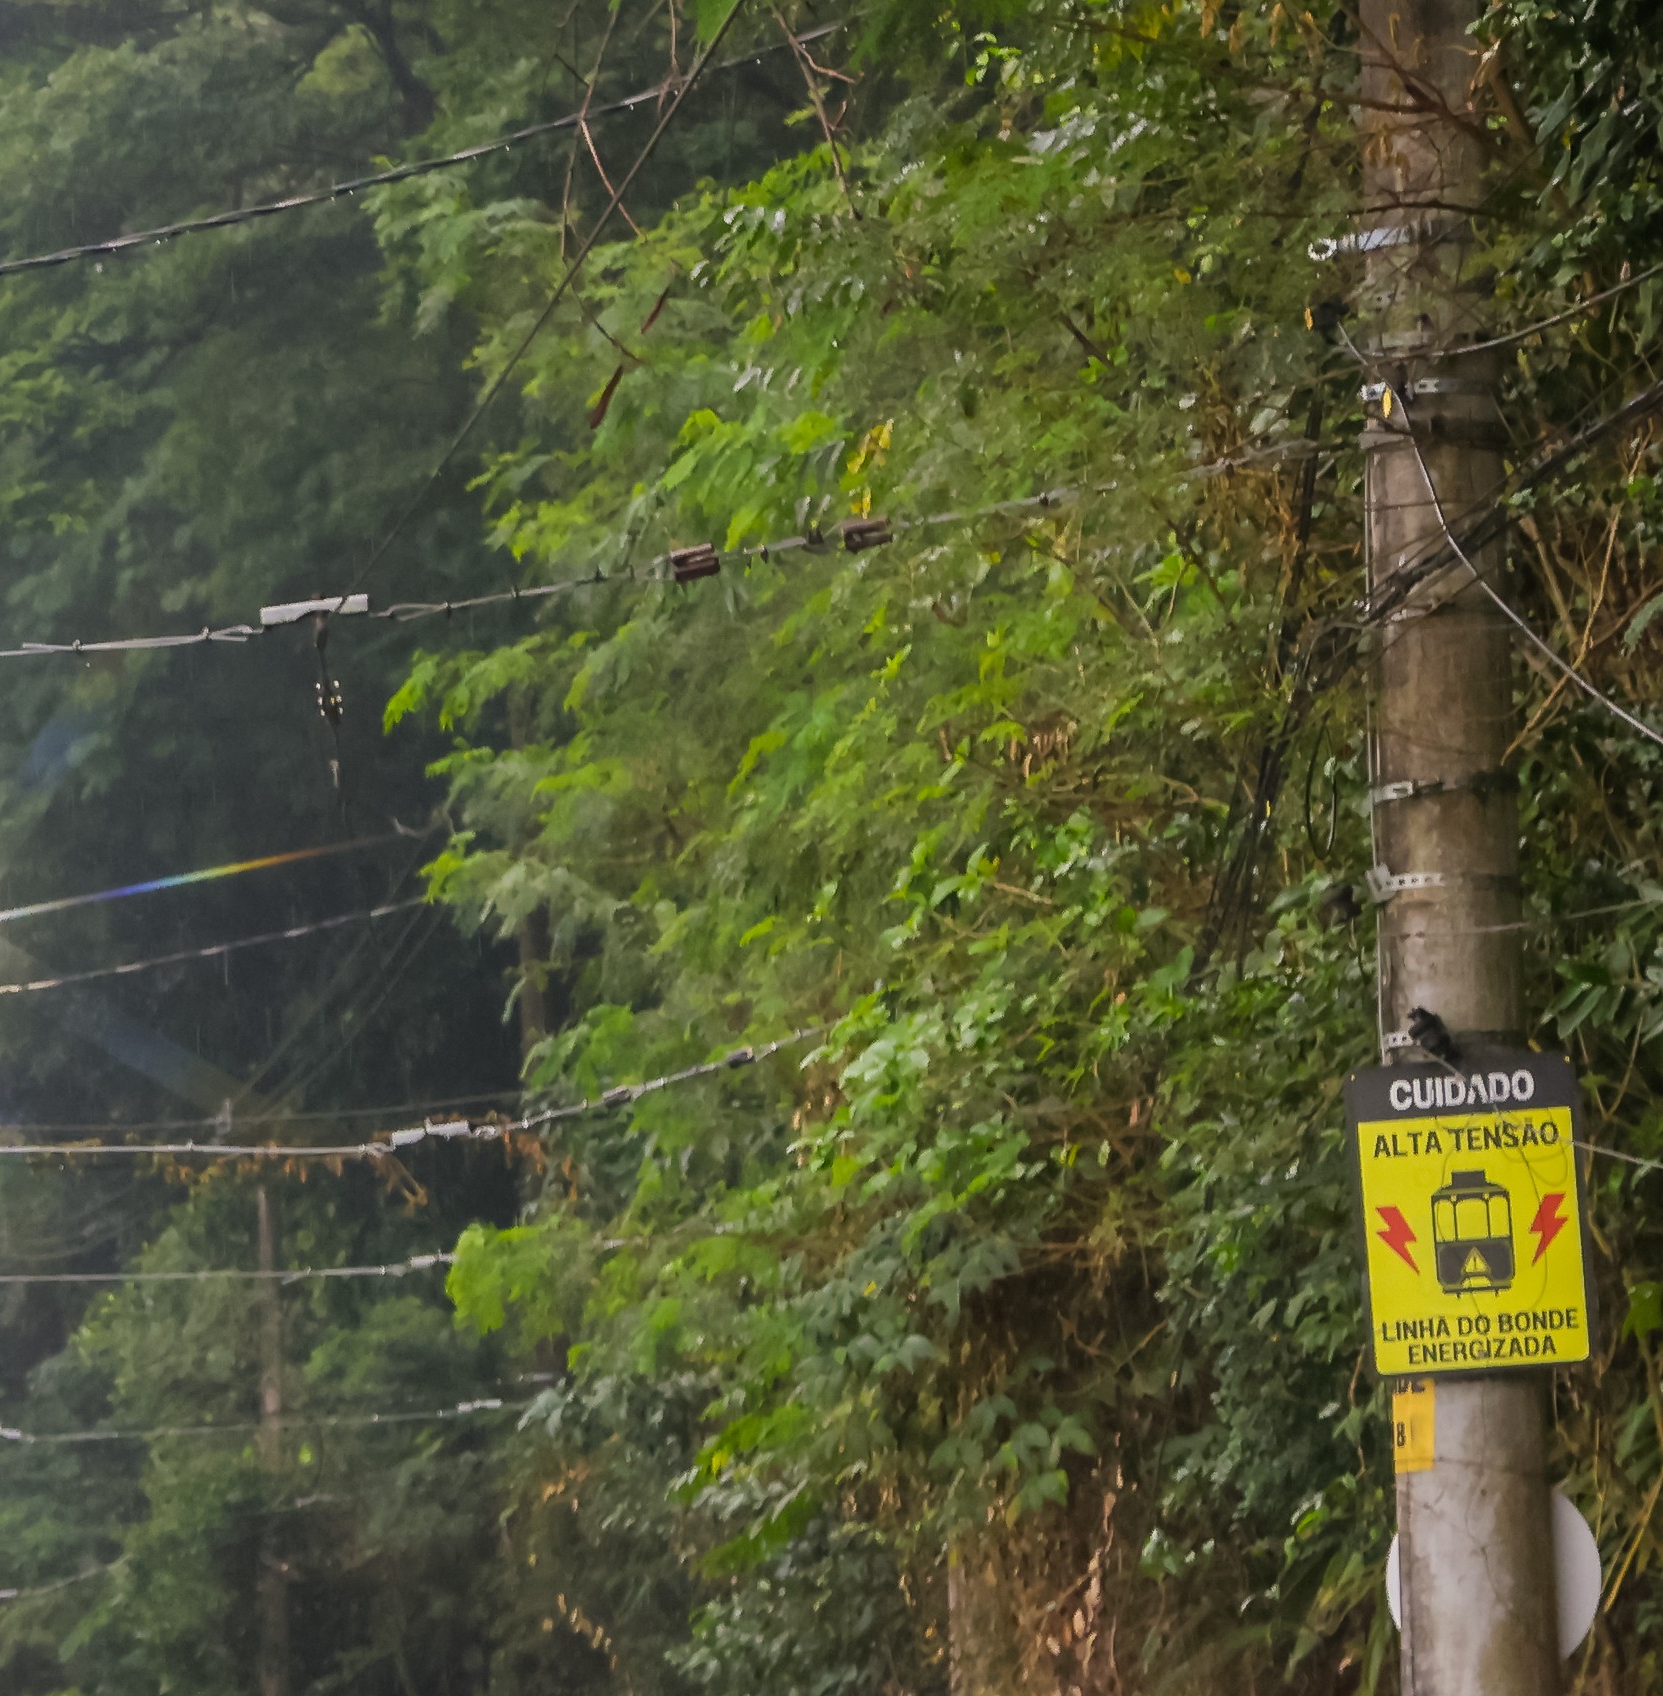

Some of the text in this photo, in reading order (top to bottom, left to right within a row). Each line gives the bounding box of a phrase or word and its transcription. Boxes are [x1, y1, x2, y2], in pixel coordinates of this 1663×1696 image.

[1389, 1069, 1535, 1111] CUIDADO
[1374, 1131, 1443, 1158] ALTA
[1381, 1307, 1579, 1341] LINHA DO BONDE
[1408, 1335, 1557, 1364] ENERGIZADA
